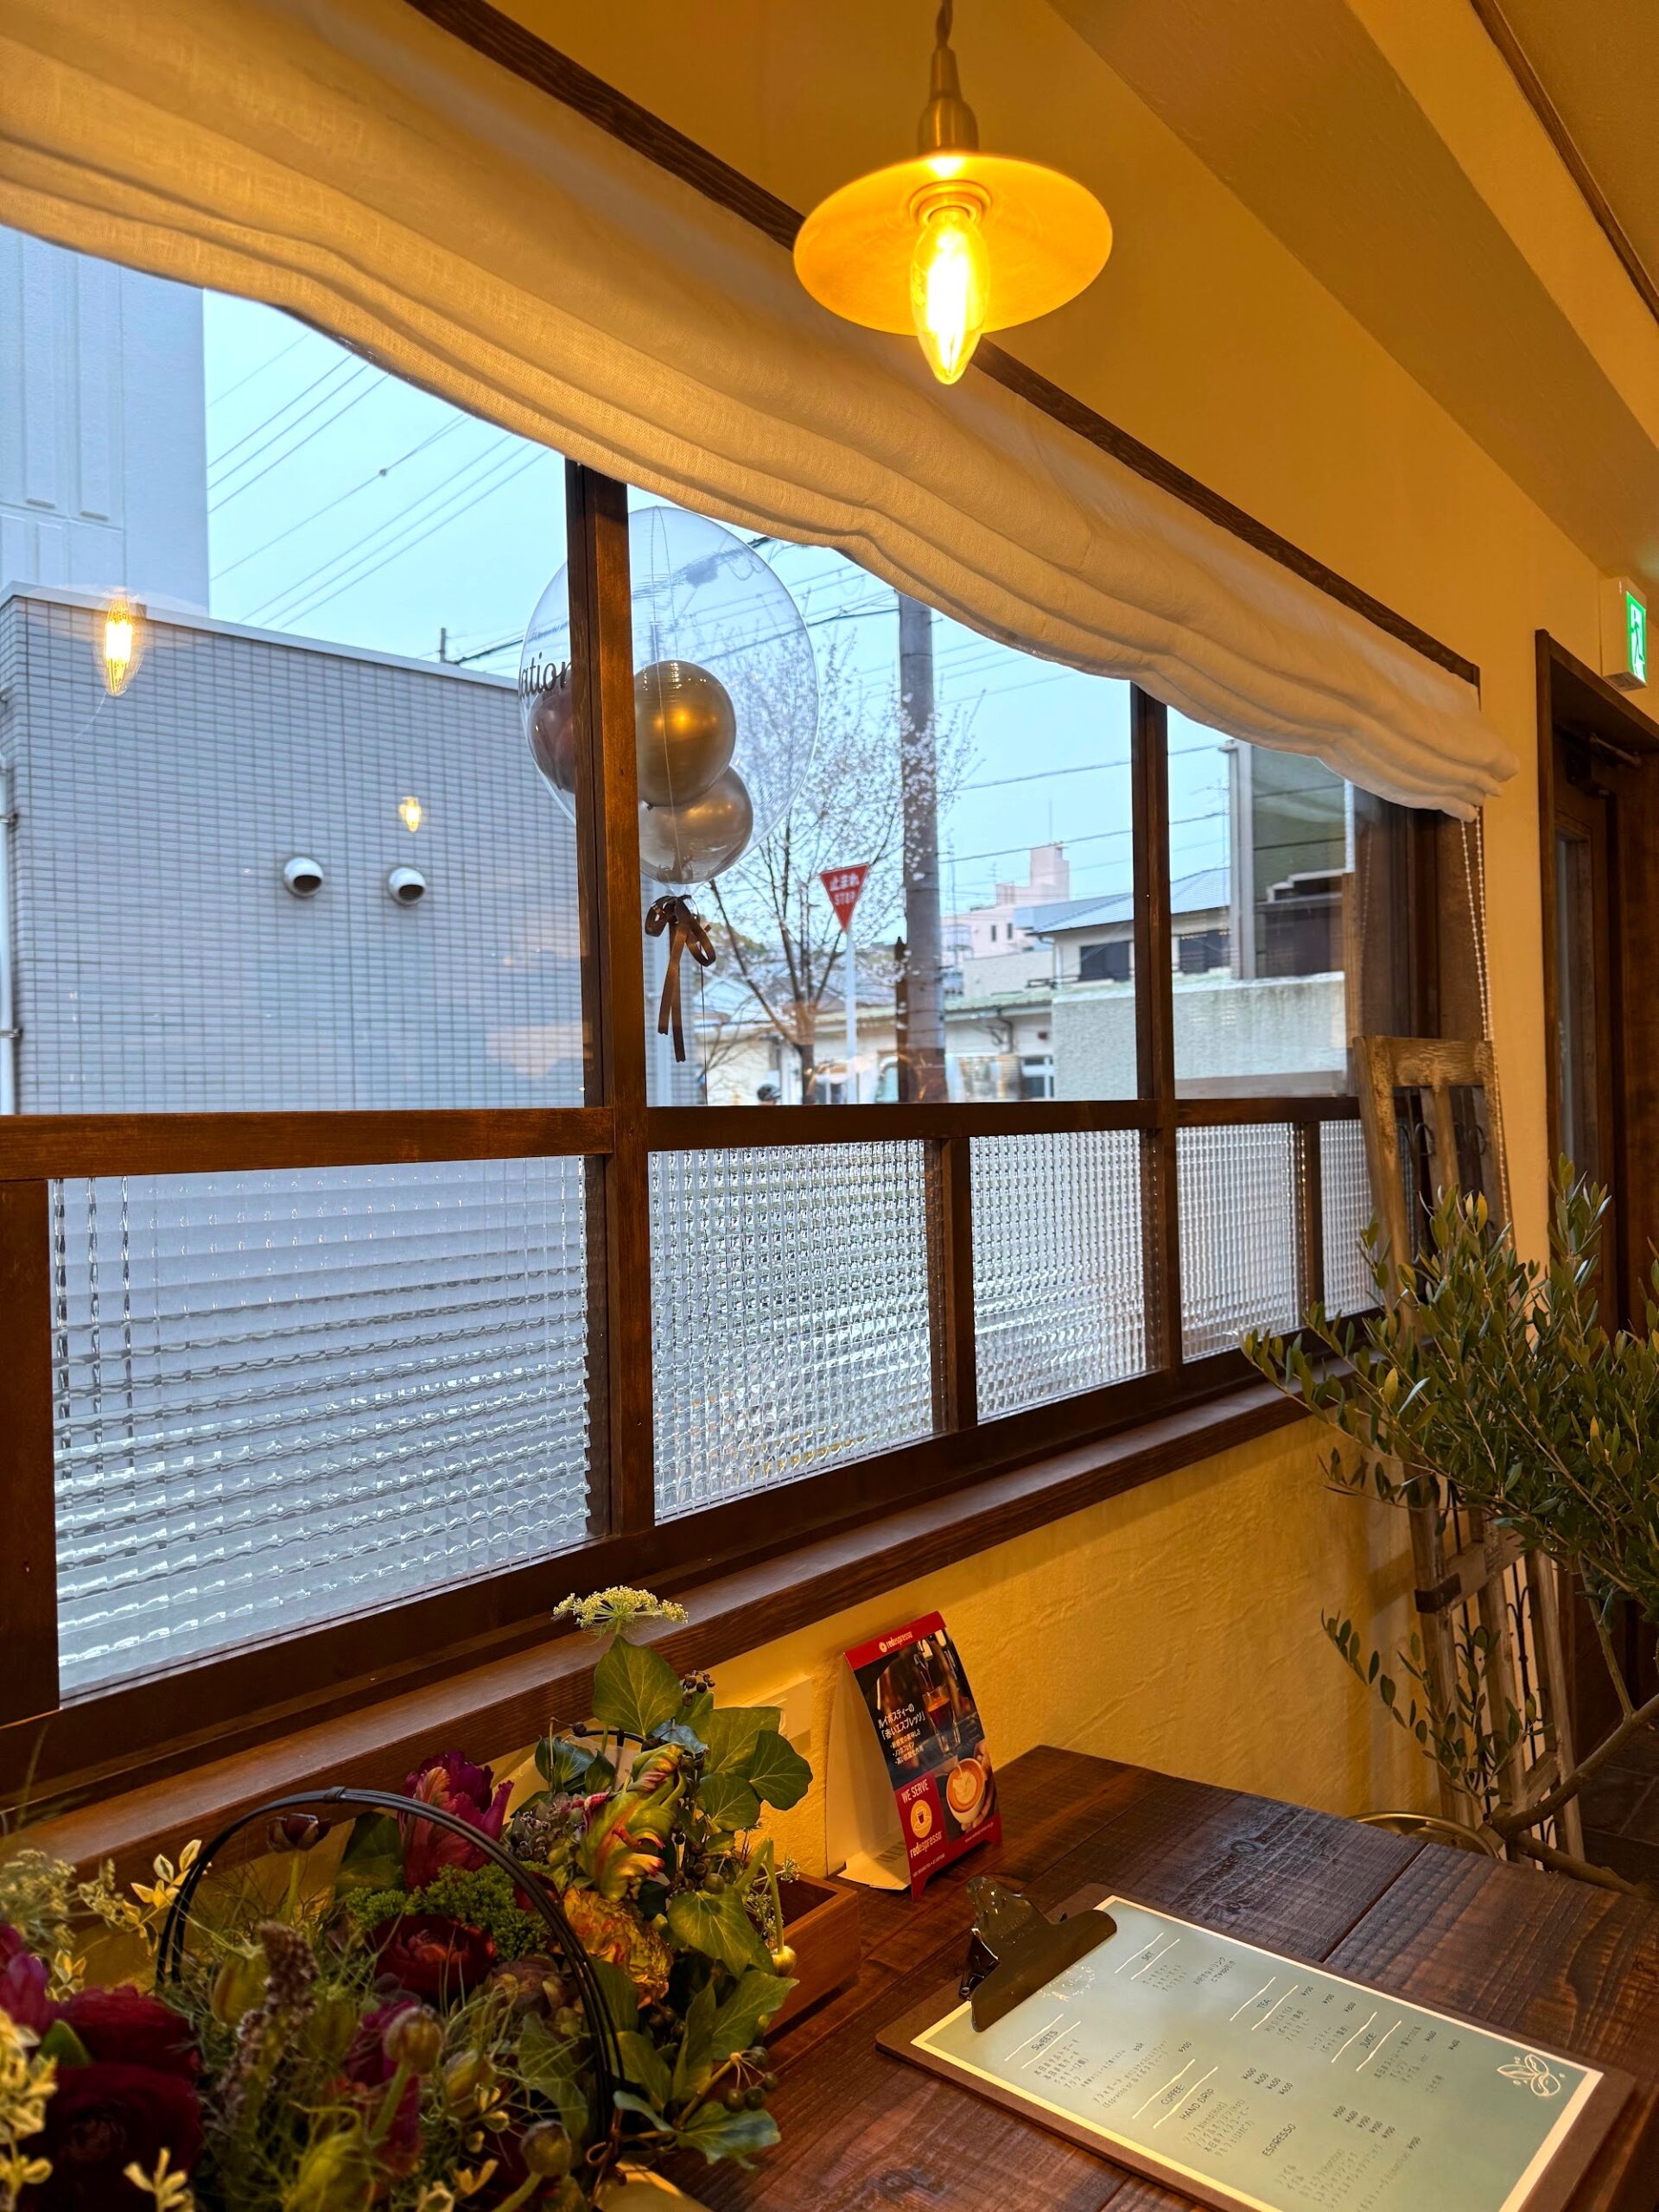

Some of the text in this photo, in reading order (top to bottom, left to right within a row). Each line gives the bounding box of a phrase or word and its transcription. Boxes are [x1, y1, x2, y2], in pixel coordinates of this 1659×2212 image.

[830, 873, 860, 892] 止まれ
[834, 891, 856, 906] STOP
[878, 1703, 915, 1729] ルイボスティーの
[901, 1779, 929, 1803] WE SERVE
[910, 1831, 942, 1859] redespresso
[1141, 1951, 1154, 1961] SET
[1031, 2031, 1058, 2050] SWEETS
[1178, 2041, 1192, 2052] ¥700
[1243, 2068, 1257, 2080] ¥600
[1254, 2073, 1269, 2085] ¥650
[1267, 2078, 1281, 2089] ¥650
[1279, 2082, 1294, 2095] ¥650
[1179, 2102, 1200, 2120] HAND
[1262, 2124, 1296, 2156] ESPRESSO
